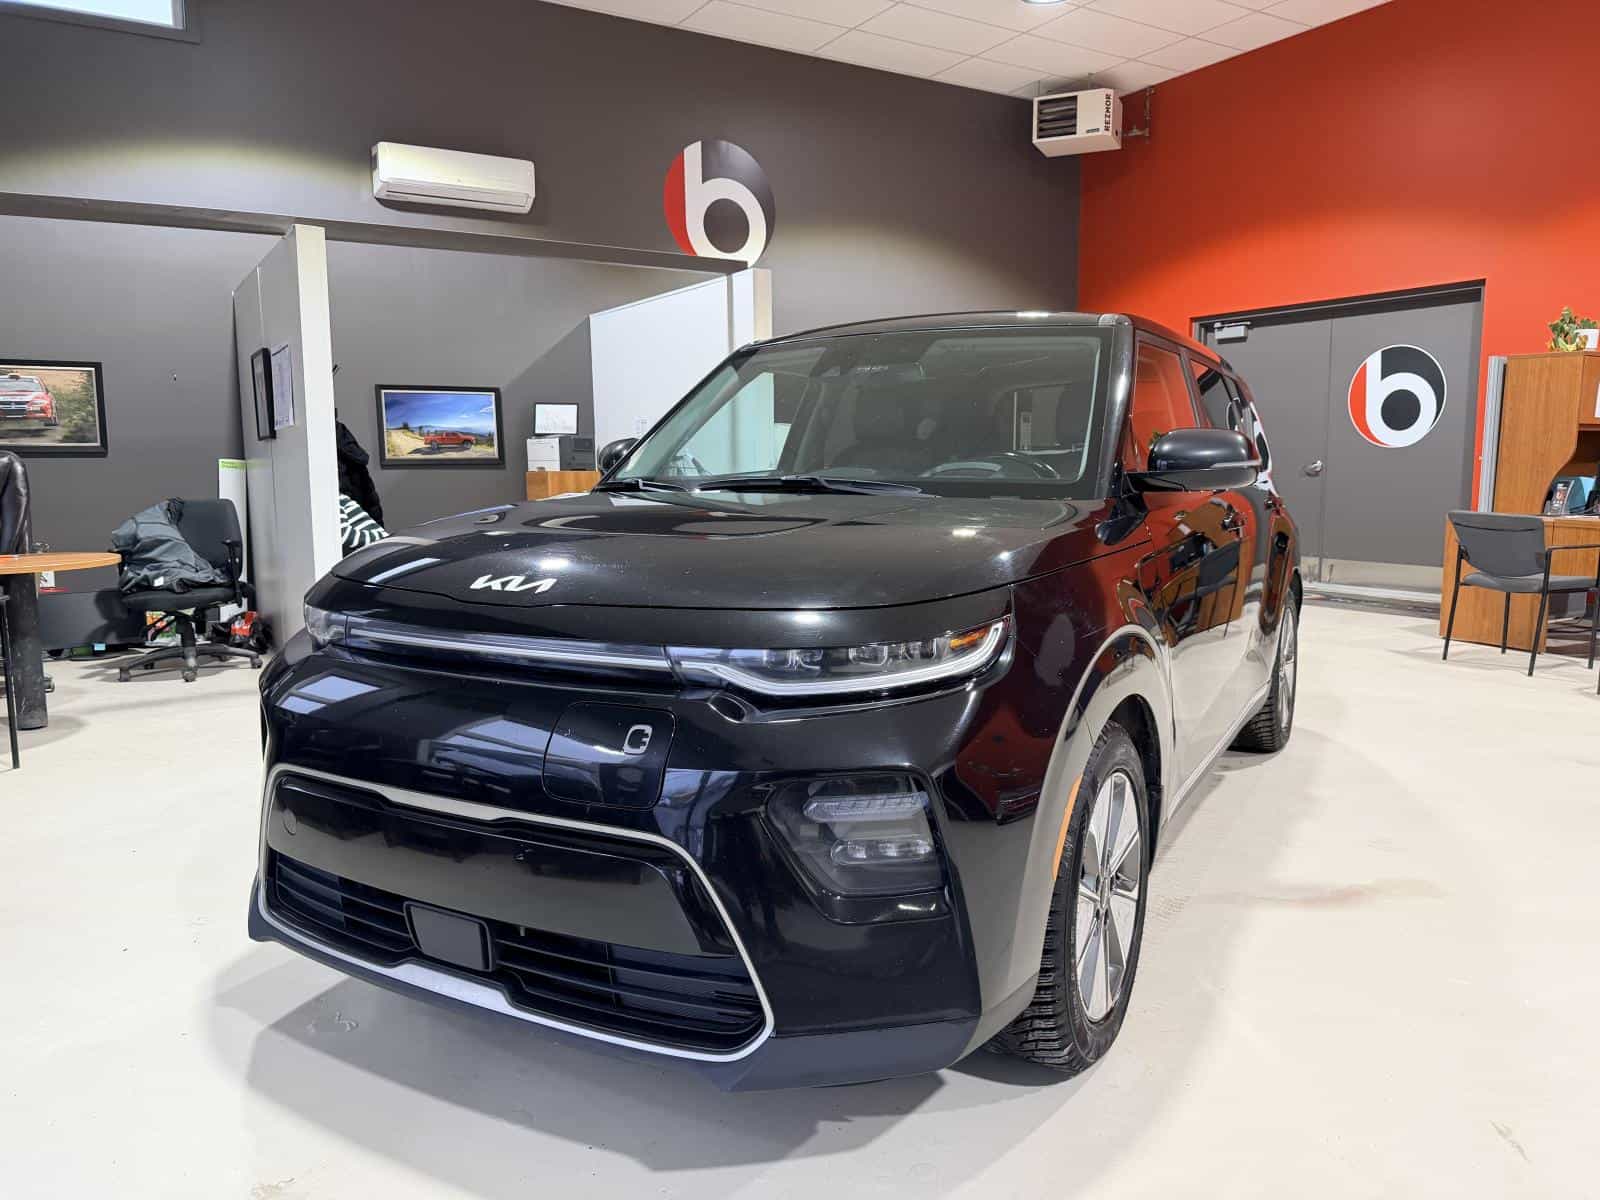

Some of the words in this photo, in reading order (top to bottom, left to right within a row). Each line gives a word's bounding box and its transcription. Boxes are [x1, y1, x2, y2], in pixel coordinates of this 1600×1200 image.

[683, 139, 767, 268] b
[1365, 349, 1438, 448] b
[469, 574, 558, 594] KIA
